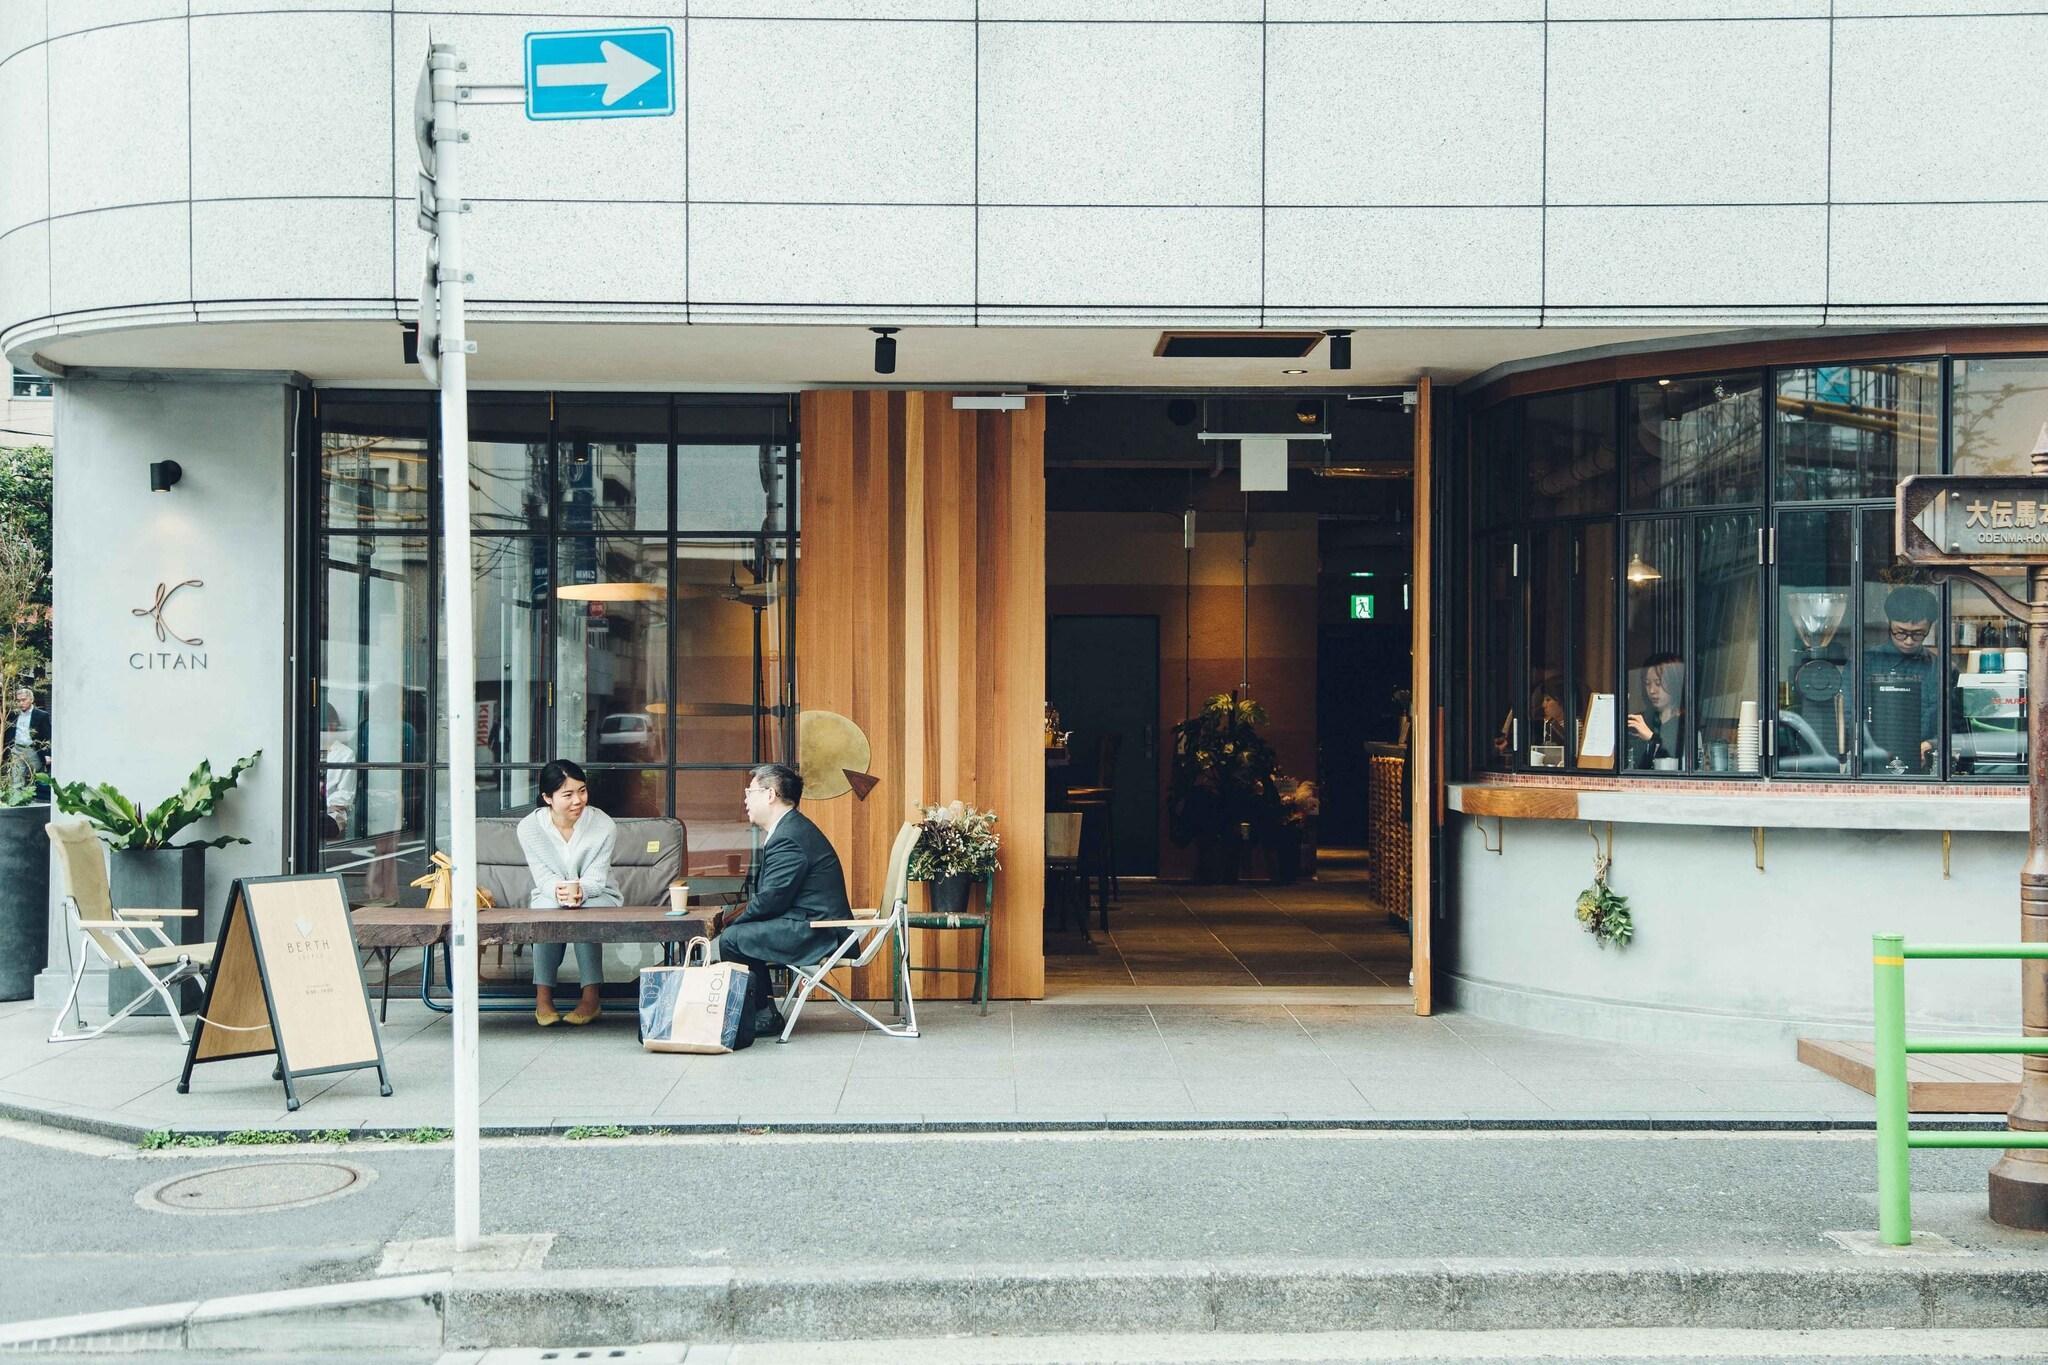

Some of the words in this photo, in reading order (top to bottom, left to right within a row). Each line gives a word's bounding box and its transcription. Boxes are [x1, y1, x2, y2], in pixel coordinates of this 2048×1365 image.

[129, 652, 207, 670] CITAN
[287, 940, 330, 953] BERTH
[706, 970, 726, 1014] TOBU
